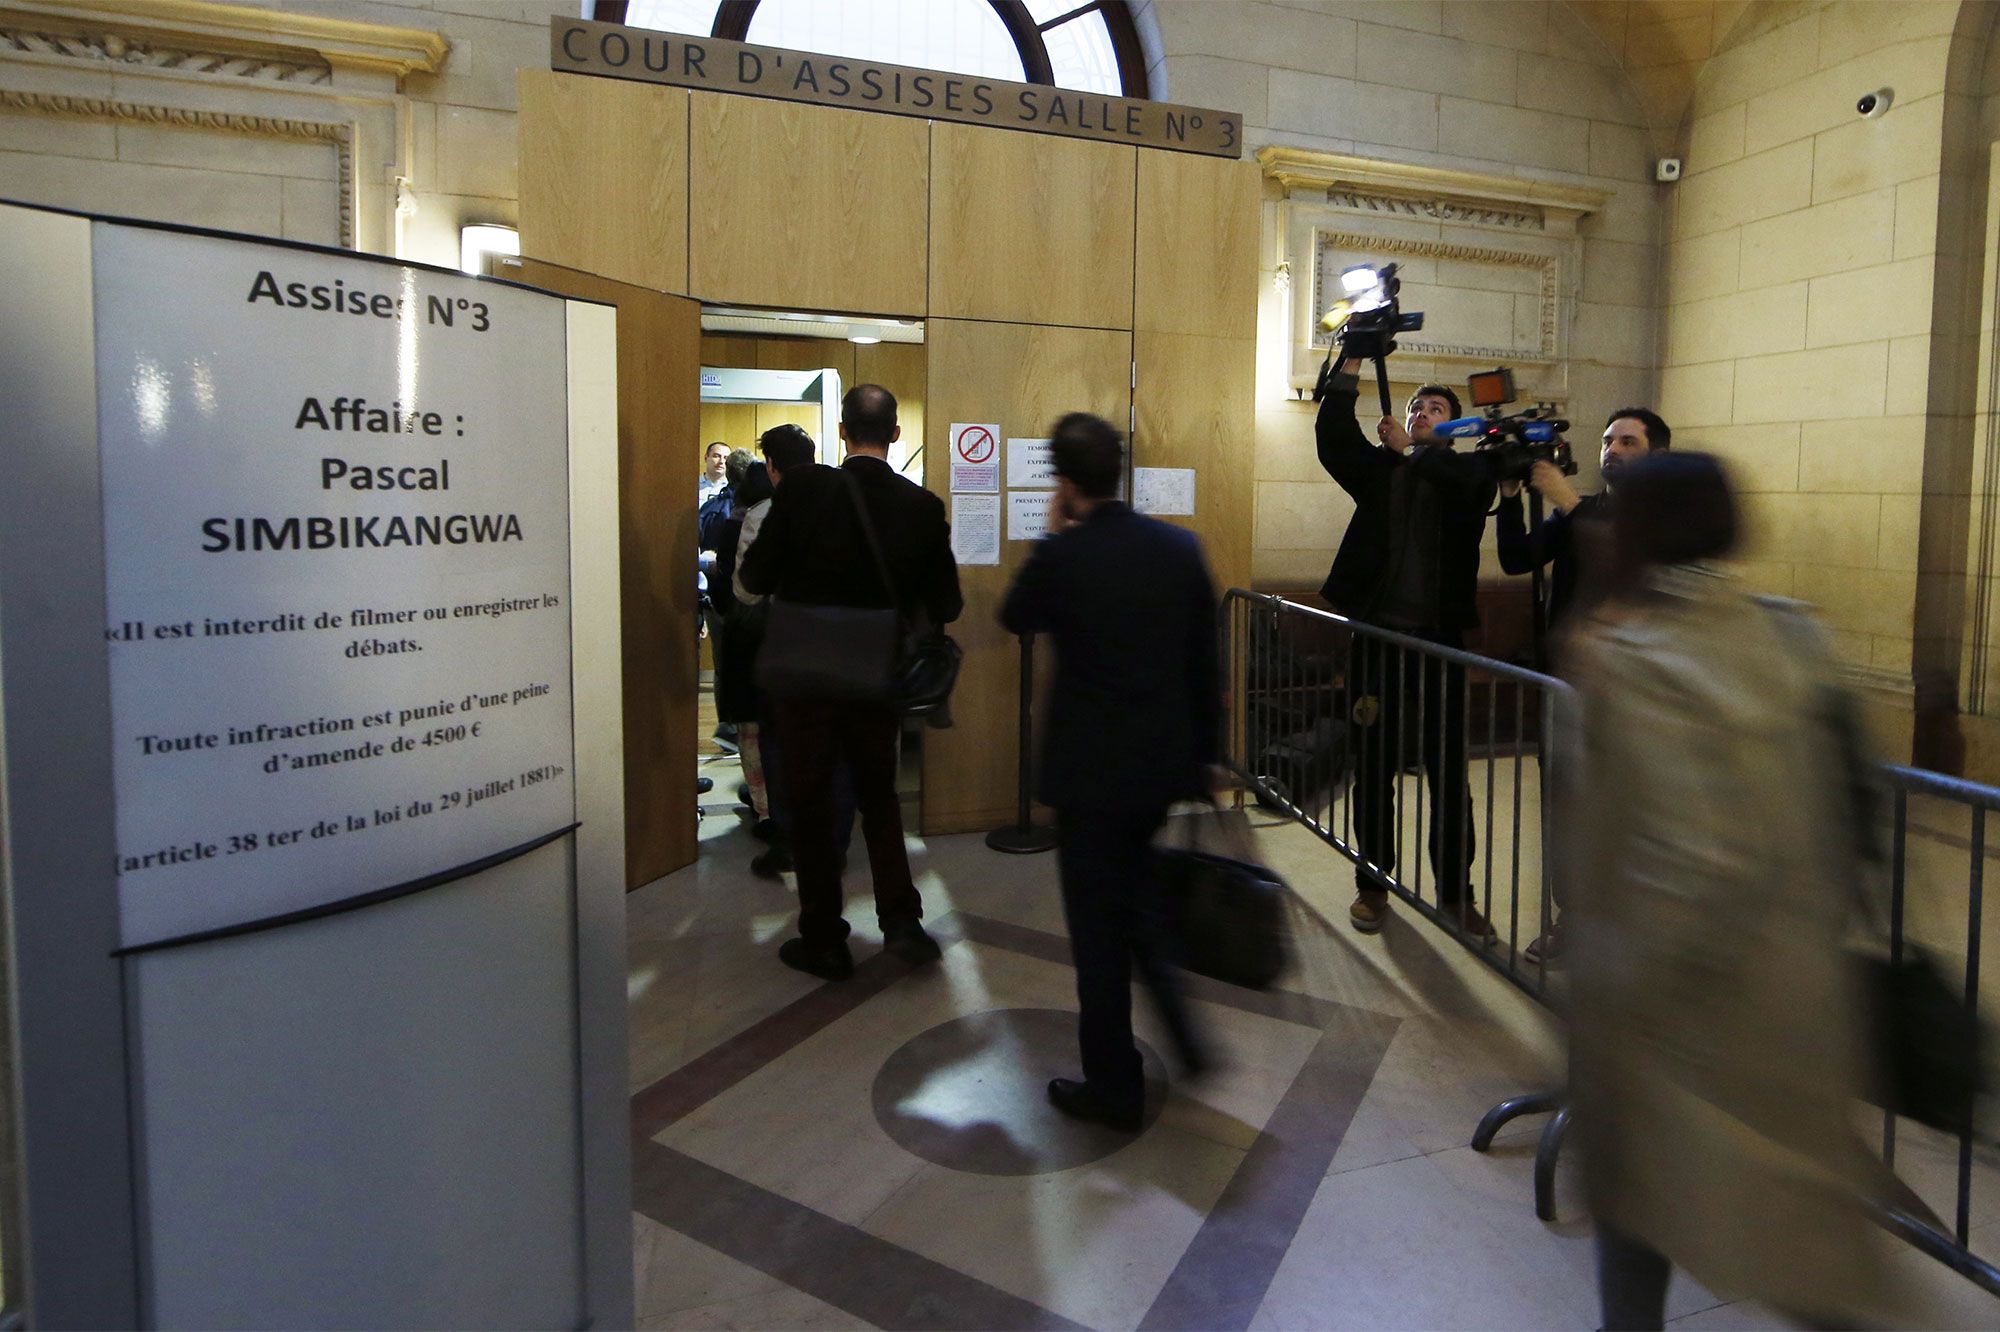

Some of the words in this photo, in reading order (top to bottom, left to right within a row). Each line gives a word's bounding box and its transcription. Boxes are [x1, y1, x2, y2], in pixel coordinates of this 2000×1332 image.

[561, 26, 708, 79] COUR
[738, 43, 994, 116] D'ASSISES
[1017, 91, 1143, 137] SALLE
[1218, 120, 1236, 149] 3
[427, 294, 490, 332] N°3
[295, 396, 443, 436] Affaire
[321, 457, 449, 491] Pascal
[201, 513, 523, 553] SIMBIKANGWA
[154, 620, 194, 640] est
[204, 613, 306, 637] interdit
[314, 612, 343, 630] de
[351, 608, 417, 627] filmer
[423, 607, 447, 622] ou
[453, 597, 541, 618] enregistrer
[543, 593, 559, 608] les
[344, 638, 423, 659] débats.
[136, 733, 218, 756] Toute
[228, 716, 354, 745] infraction
[362, 711, 392, 729] est
[399, 700, 455, 727] punie
[512, 683, 549, 706] peine
[390, 736, 416, 754] de
[421, 724, 466, 747] 4500
[471, 721, 482, 738] €
[226, 833, 258, 855] 38
[266, 829, 303, 847] ter
[311, 821, 339, 839] de
[346, 815, 366, 832] la
[374, 805, 400, 826] loi
[407, 801, 433, 818] du
[440, 791, 461, 810] 29
[466, 778, 515, 809] juillet
